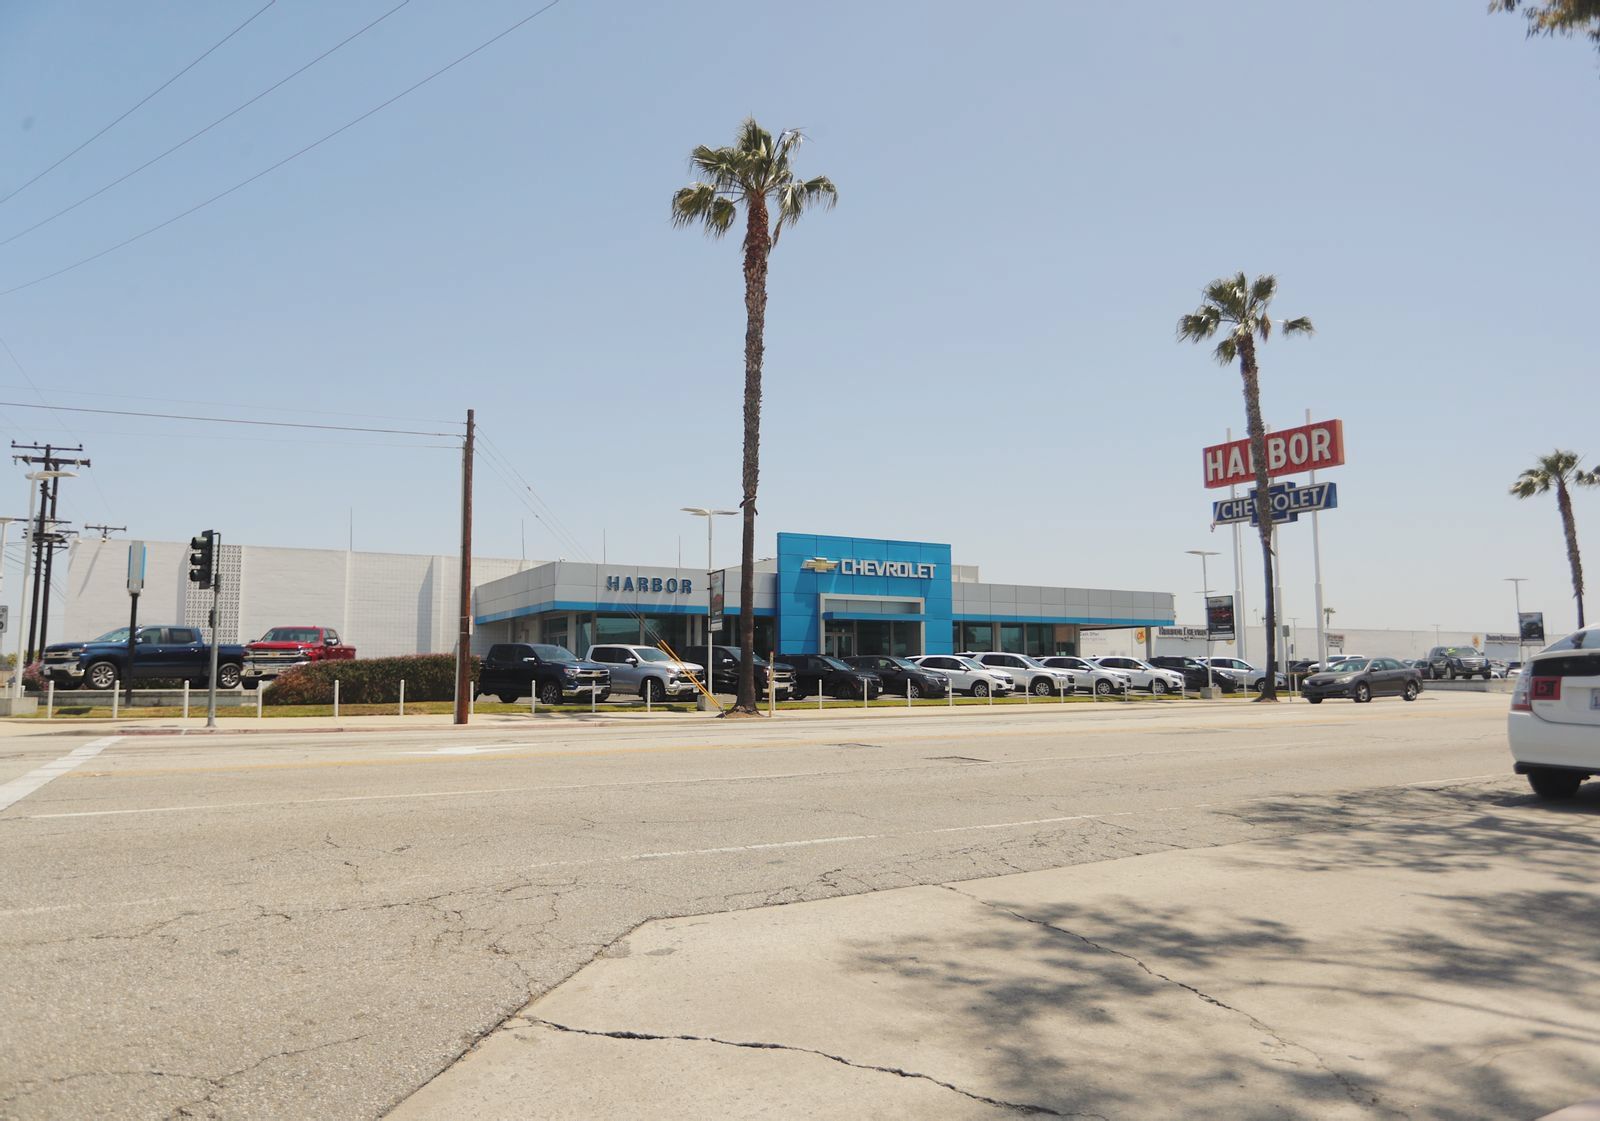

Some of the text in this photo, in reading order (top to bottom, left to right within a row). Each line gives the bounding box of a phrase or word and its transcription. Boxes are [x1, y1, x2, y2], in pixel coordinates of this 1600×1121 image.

[1221, 488, 1320, 519] CHEOLET
[841, 558, 937, 579] CHEVROLET
[606, 575, 693, 595] HARBOR
